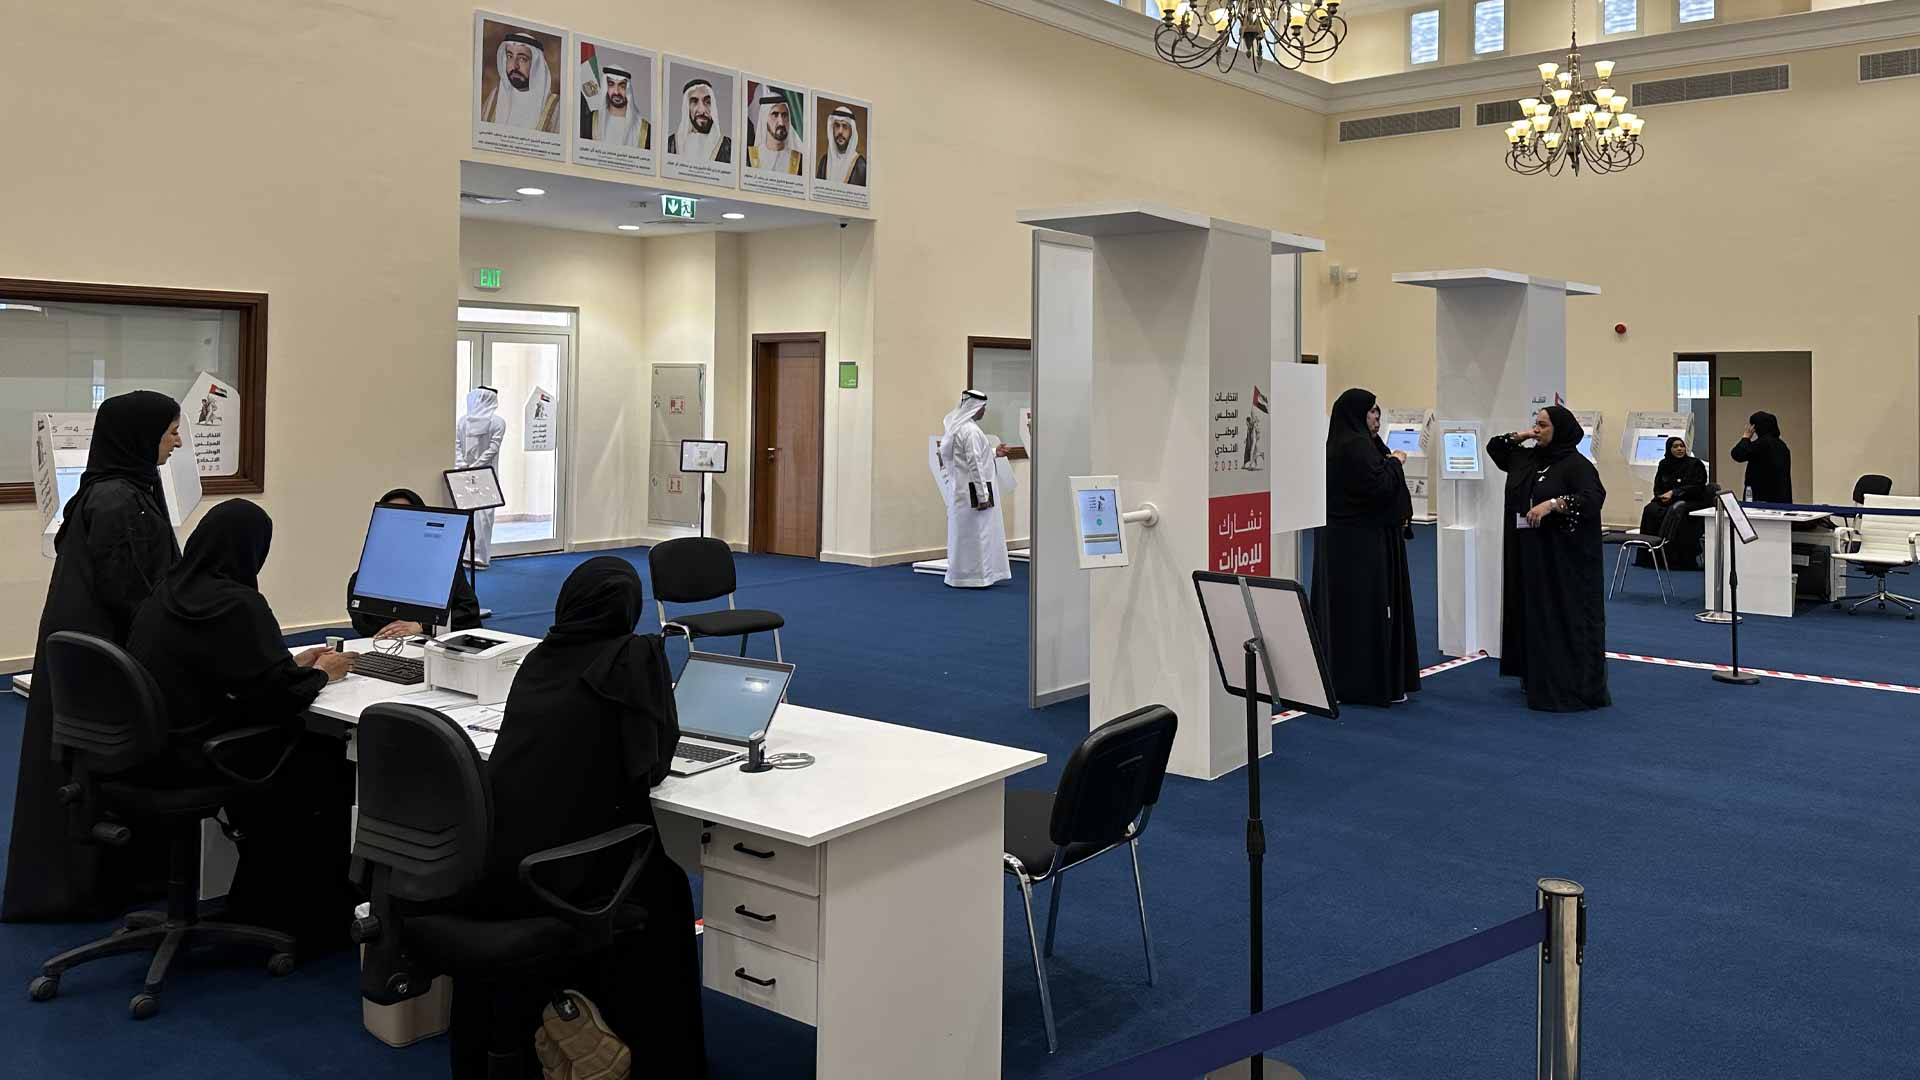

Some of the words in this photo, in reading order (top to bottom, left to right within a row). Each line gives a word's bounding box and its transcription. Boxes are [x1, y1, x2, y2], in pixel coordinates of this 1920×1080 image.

[480, 268, 501, 287] EXIT
[1214, 409, 1238, 421] المجلس
[1214, 426, 1238, 441] الوطني
[1214, 443, 1238, 458] الاتحادي
[1214, 459, 1238, 472] 2023
[1219, 508, 1262, 540] نشارك
[1219, 543, 1262, 575] للإمارات
